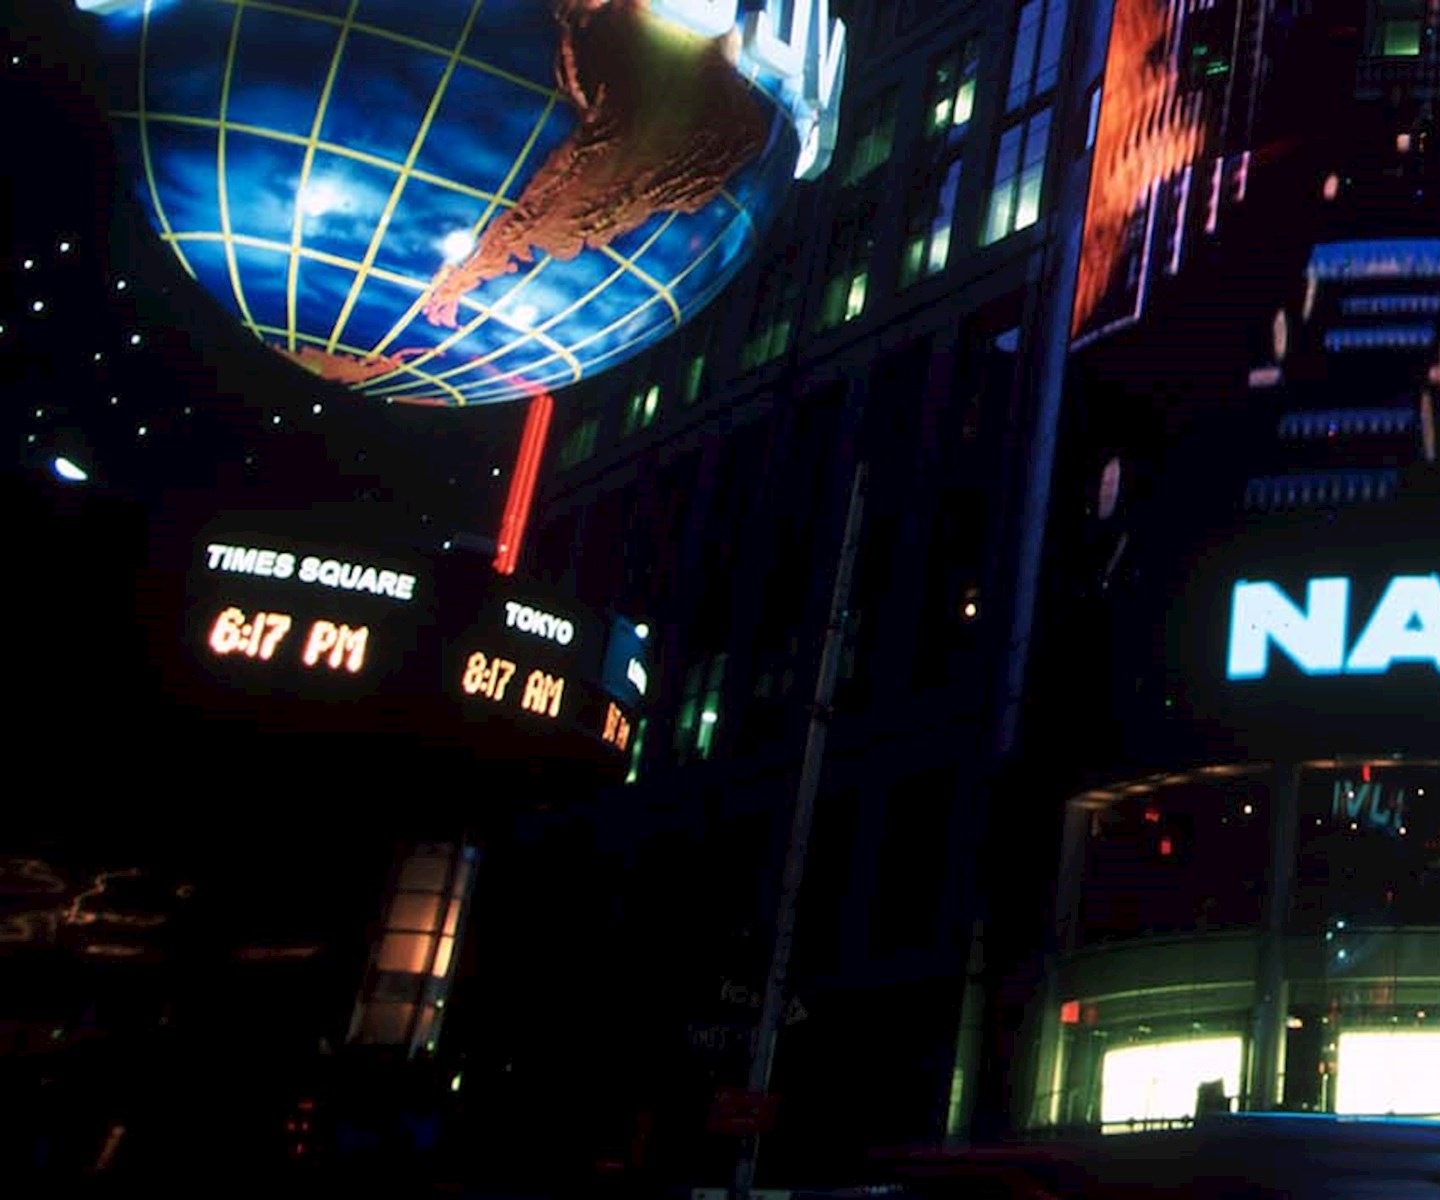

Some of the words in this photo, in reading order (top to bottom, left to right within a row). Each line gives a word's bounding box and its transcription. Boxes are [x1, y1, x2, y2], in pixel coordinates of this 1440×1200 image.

[207, 544, 296, 580] TIMES
[299, 556, 417, 601] SQUARE
[209, 605, 293, 662] 6:17
[302, 619, 370, 674] PM
[505, 601, 575, 646] TOKYO
[462, 650, 517, 702] 8:17
[520, 668, 566, 719] AM
